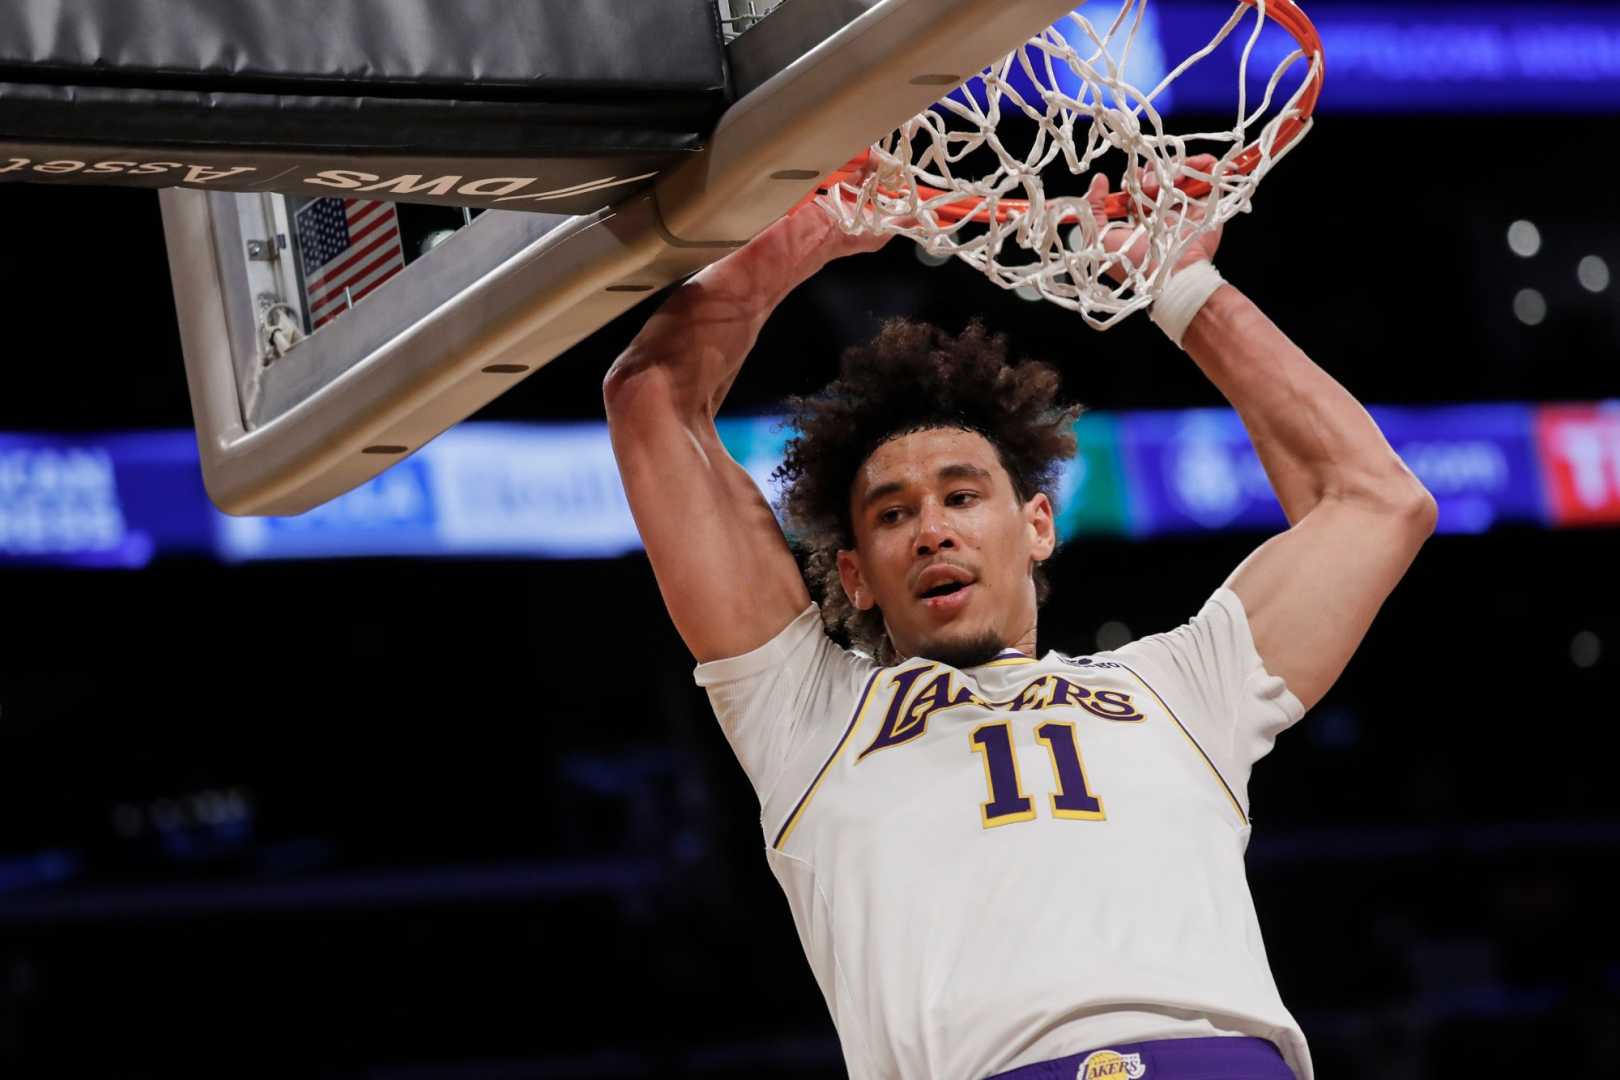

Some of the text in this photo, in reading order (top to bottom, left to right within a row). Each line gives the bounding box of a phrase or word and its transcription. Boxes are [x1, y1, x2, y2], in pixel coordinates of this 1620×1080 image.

[0, 158, 538, 196] DWS Asset
[967, 719, 1108, 830] 11
